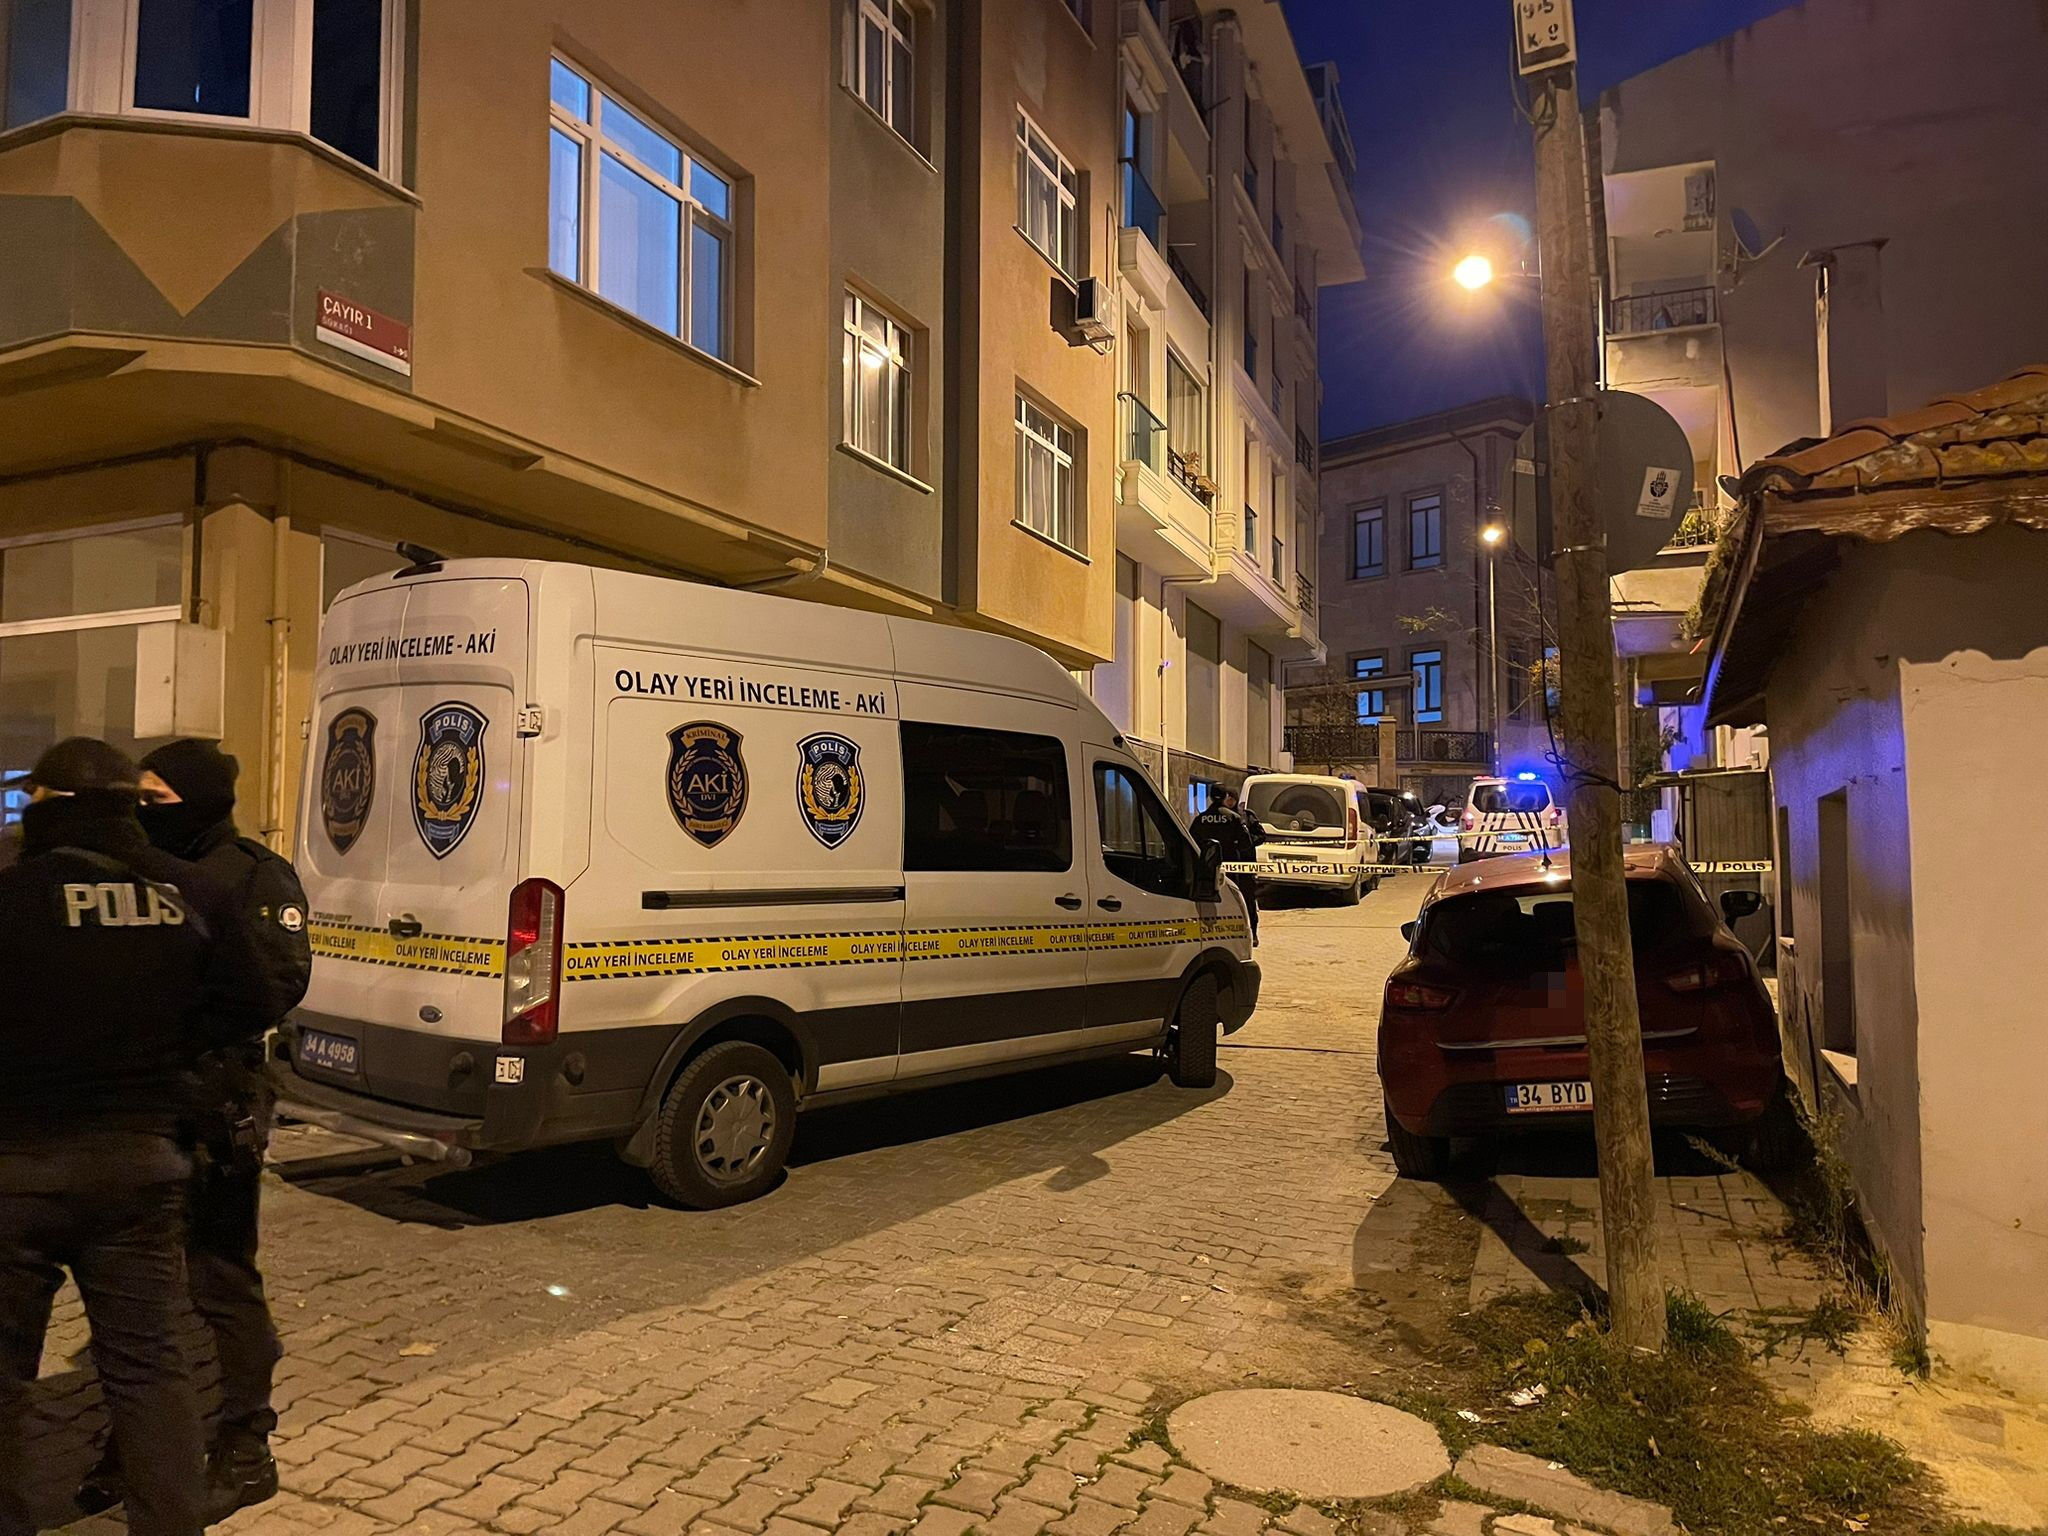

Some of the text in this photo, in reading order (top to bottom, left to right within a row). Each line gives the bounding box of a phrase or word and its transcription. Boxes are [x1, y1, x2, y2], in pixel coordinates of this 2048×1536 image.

[323, 297, 373, 330] ÇAYIR 1
[329, 643, 357, 665] OLAY
[357, 636, 385, 662] YERİ
[385, 634, 454, 659] İNCELEME
[465, 628, 496, 654] AKİ
[615, 669, 678, 696] OLAY
[683, 675, 735, 701] YERİ
[740, 676, 841, 710] İNCELEME
[855, 691, 886, 714] AKİ
[812, 742, 846, 755] POLİS
[687, 771, 728, 794] AKİ
[958, 938, 980, 949] OLAY
[1049, 934, 1068, 944] OLAY
[1128, 931, 1144, 941] OLAY
[396, 943, 490, 965] OLAY YERİ İNCELEME
[722, 945, 828, 961] OLAY YERİ İNCELEME
[850, 943, 875, 955] OLAY
[876, 941, 896, 953] YERİ
[567, 951, 694, 969] OLAY YERİ İNCELEME
[318, 1038, 326, 1056] A
[1519, 1085, 1542, 1105] 34
[1551, 1083, 1587, 1103] BYD
